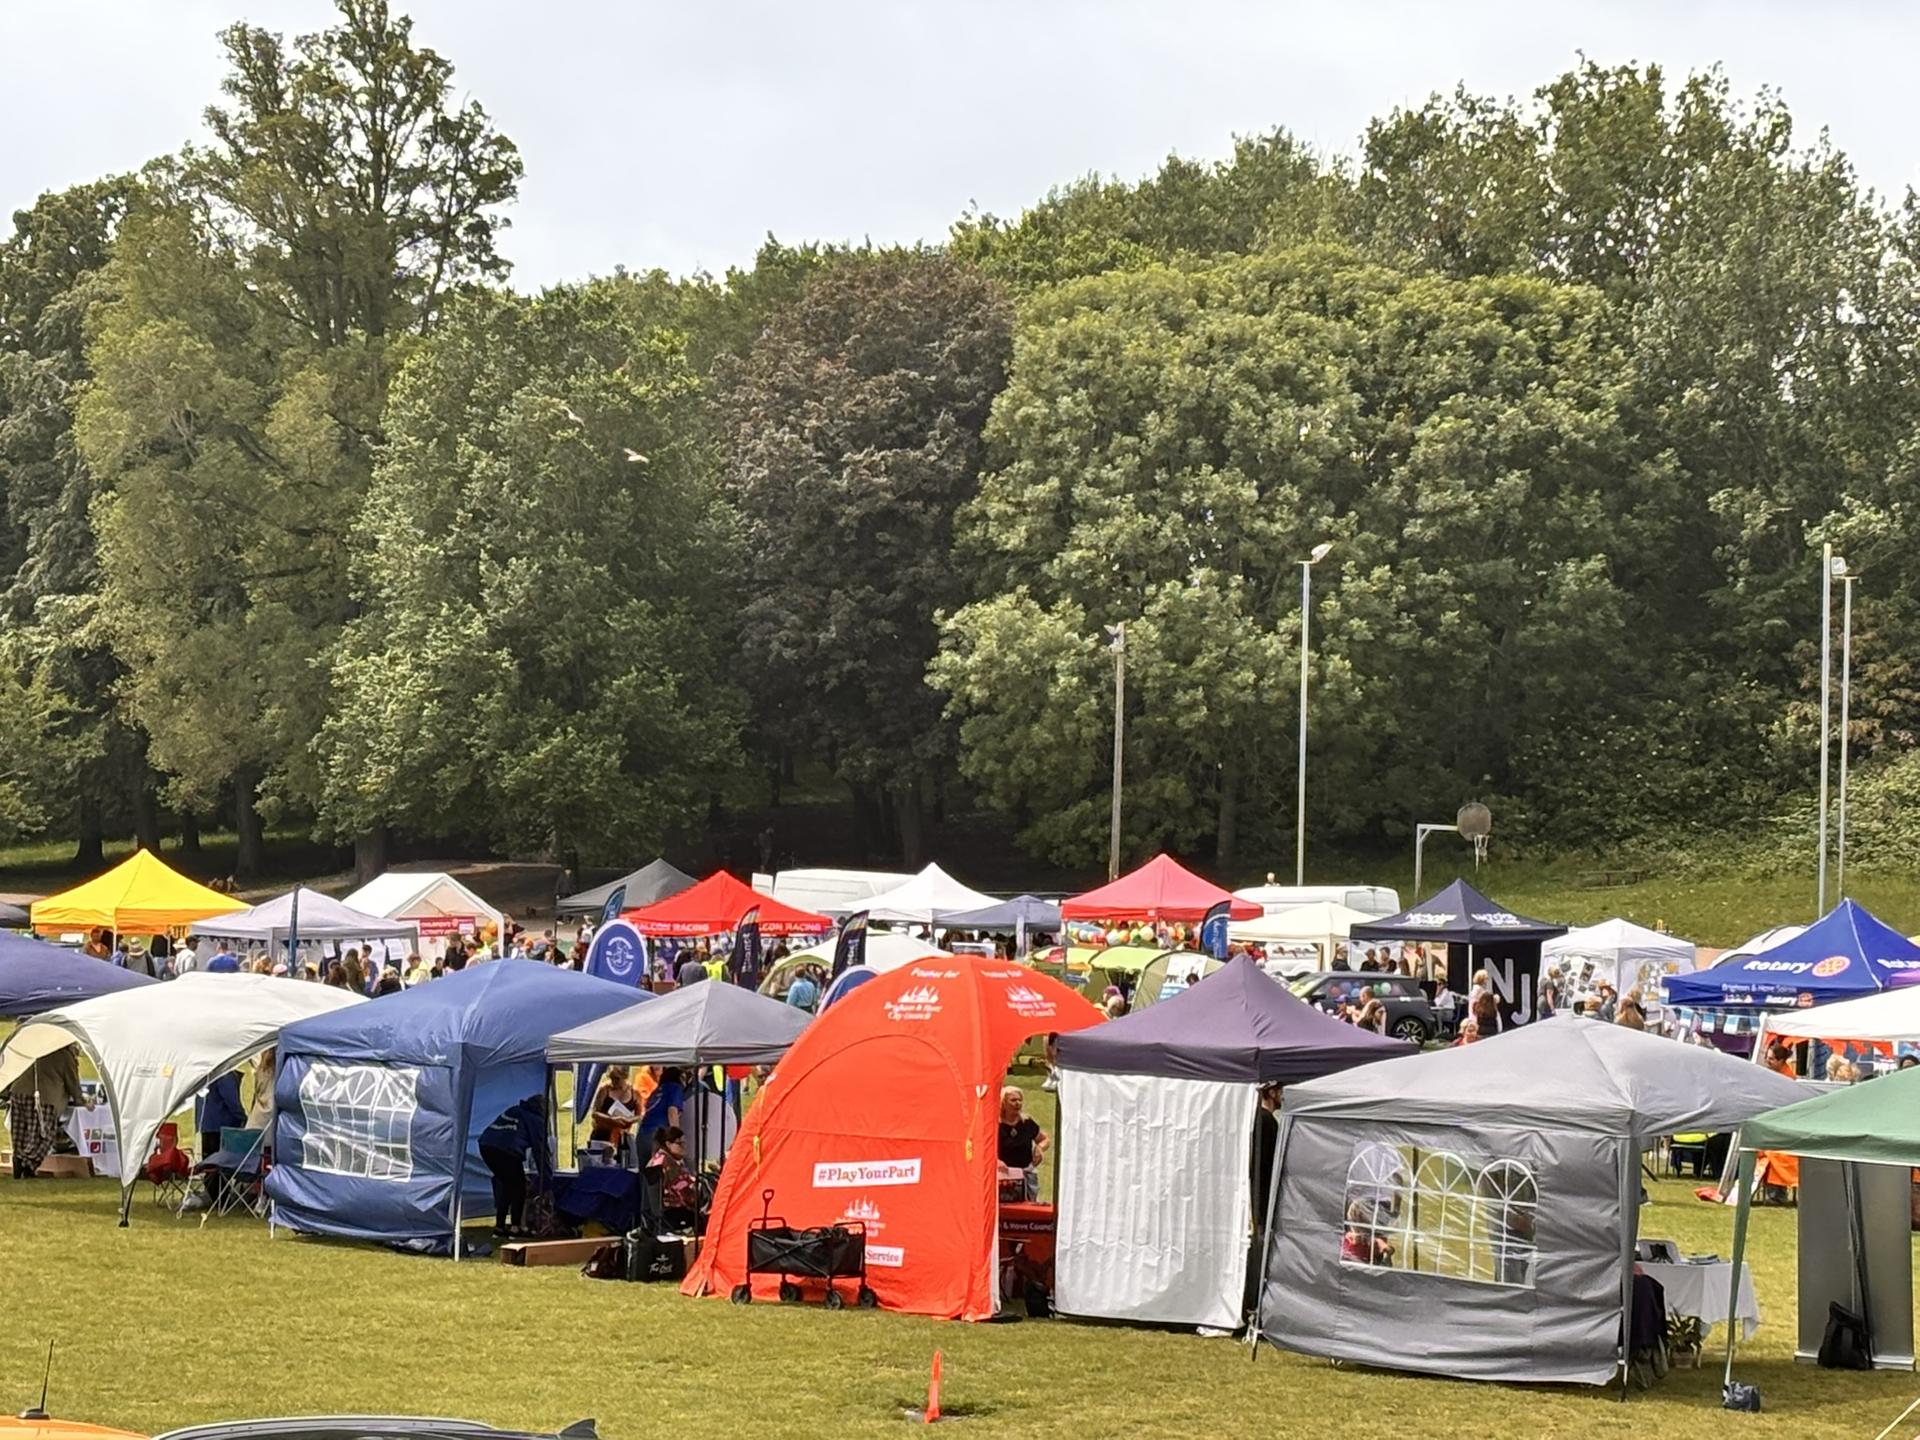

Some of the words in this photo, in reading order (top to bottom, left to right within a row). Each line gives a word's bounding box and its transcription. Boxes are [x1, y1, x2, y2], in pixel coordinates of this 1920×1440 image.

[1743, 961, 1814, 974] Rotary
[1765, 995, 1797, 1007] Rotary
[818, 1165, 916, 1183] #PlayYourPart
[866, 1249, 901, 1262] Service
